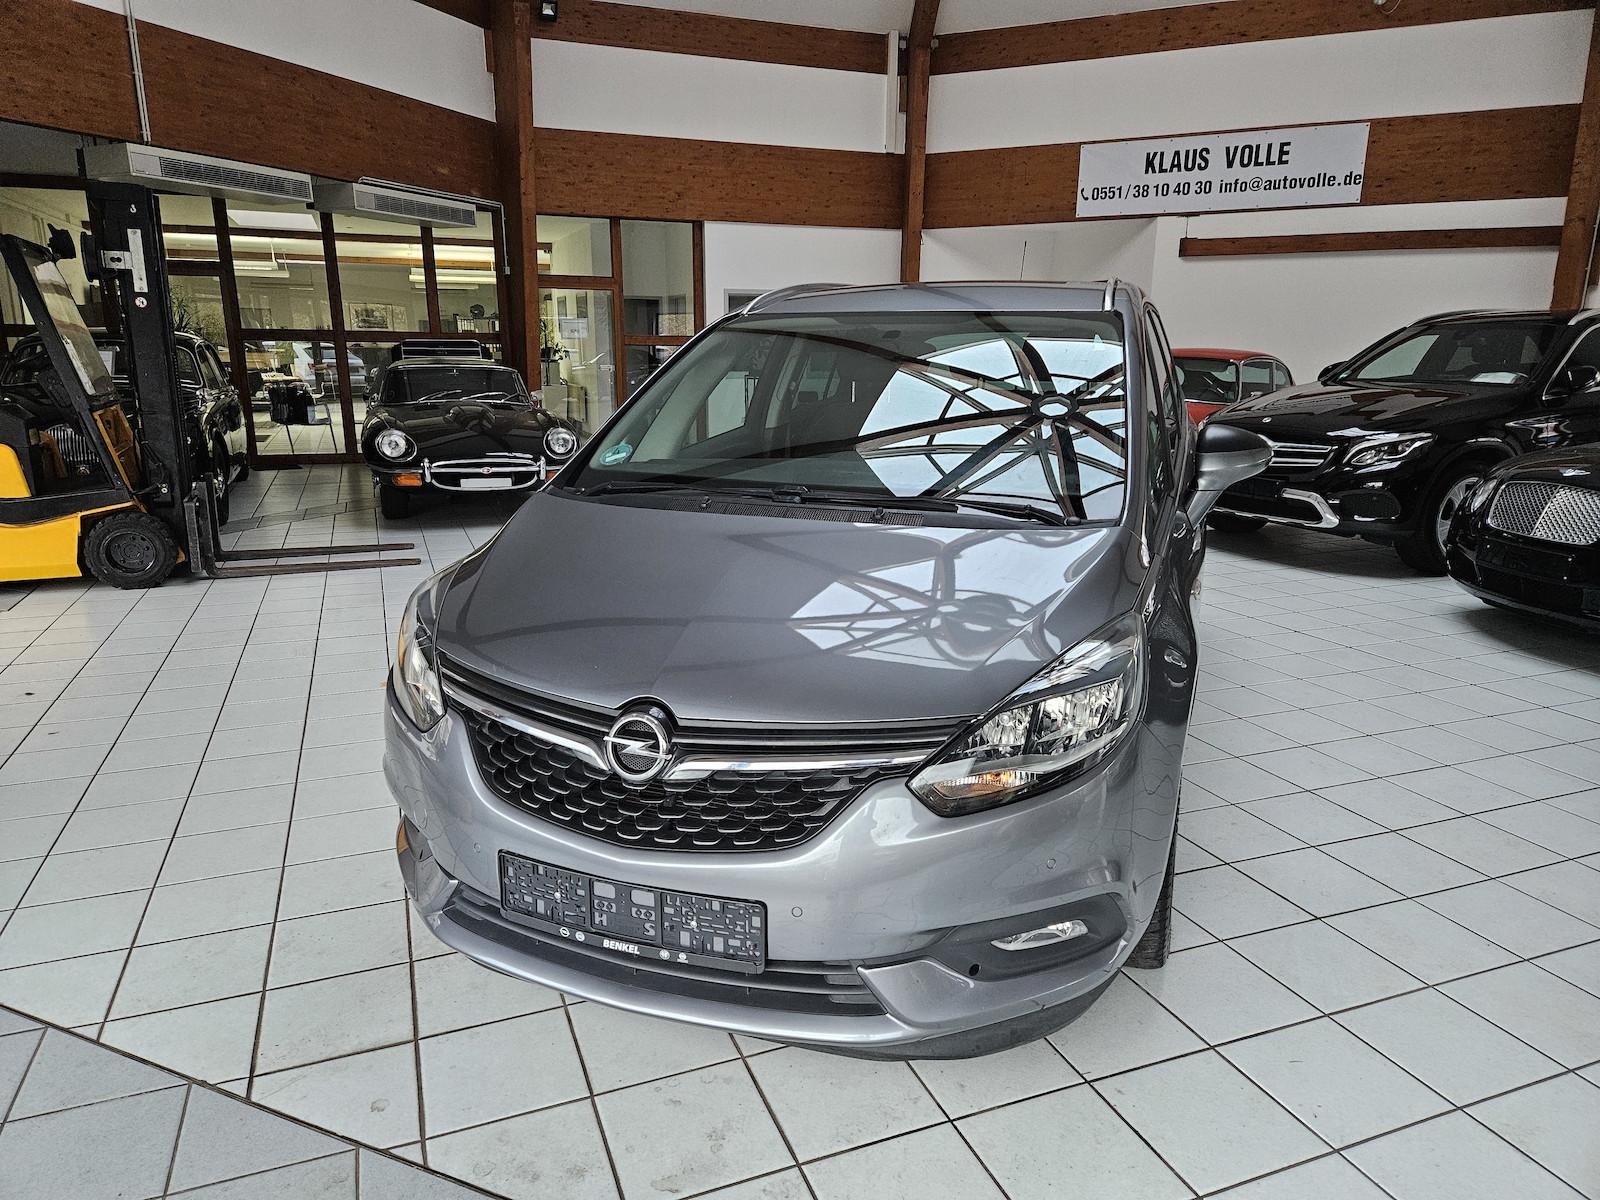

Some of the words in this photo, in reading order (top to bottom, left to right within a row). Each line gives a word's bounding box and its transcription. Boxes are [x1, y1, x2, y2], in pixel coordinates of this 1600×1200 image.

[1144, 147, 1211, 175] KLAUS
[1225, 141, 1292, 169] VOLLE
[1153, 182, 1170, 197] 10
[1172, 181, 1191, 196] 40
[1194, 180, 1213, 195] 30
[1218, 171, 1362, 194] info@autovolle.de
[602, 939, 640, 954] BENKEL
